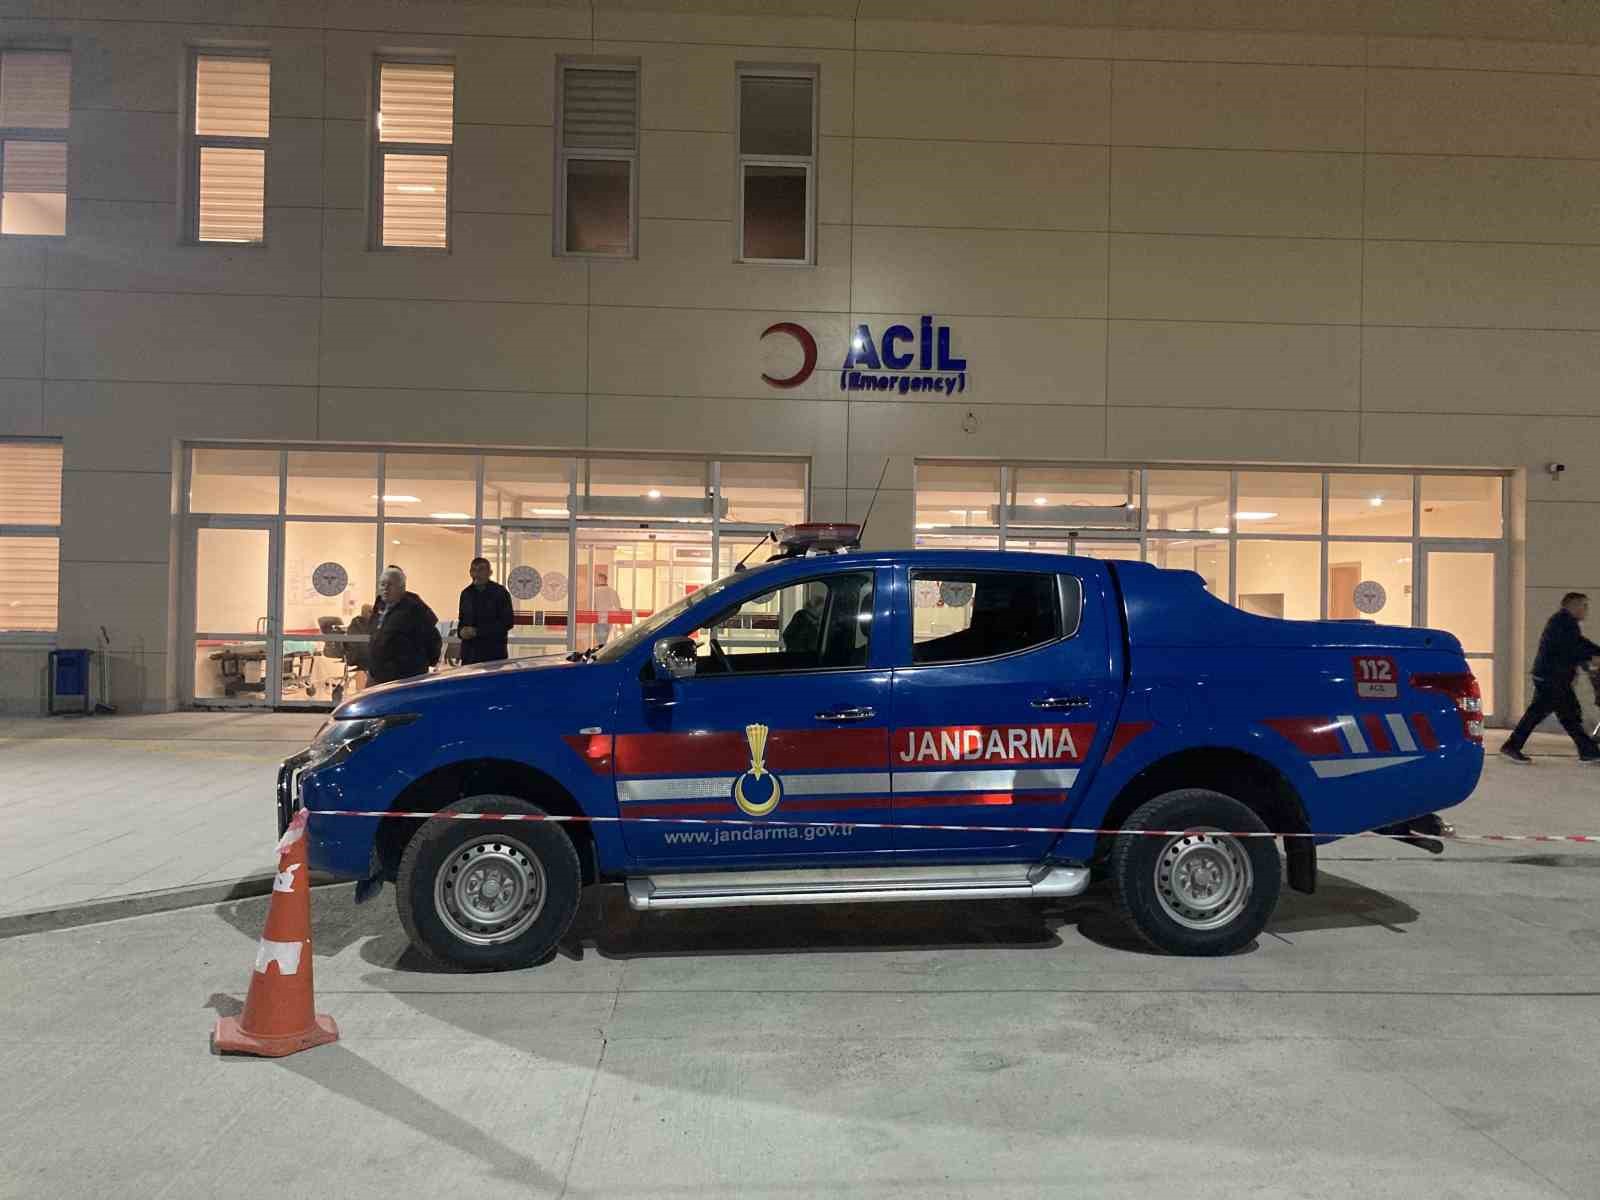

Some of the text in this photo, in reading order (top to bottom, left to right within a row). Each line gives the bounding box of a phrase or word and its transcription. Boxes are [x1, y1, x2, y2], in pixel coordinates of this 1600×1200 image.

[843, 315, 967, 371] ACİL
[840, 372, 966, 395] (Emergency)
[1359, 659, 1392, 680] 112
[899, 727, 1078, 763] JANDARMA
[664, 822, 856, 845] www.jandarma.gov.tr
